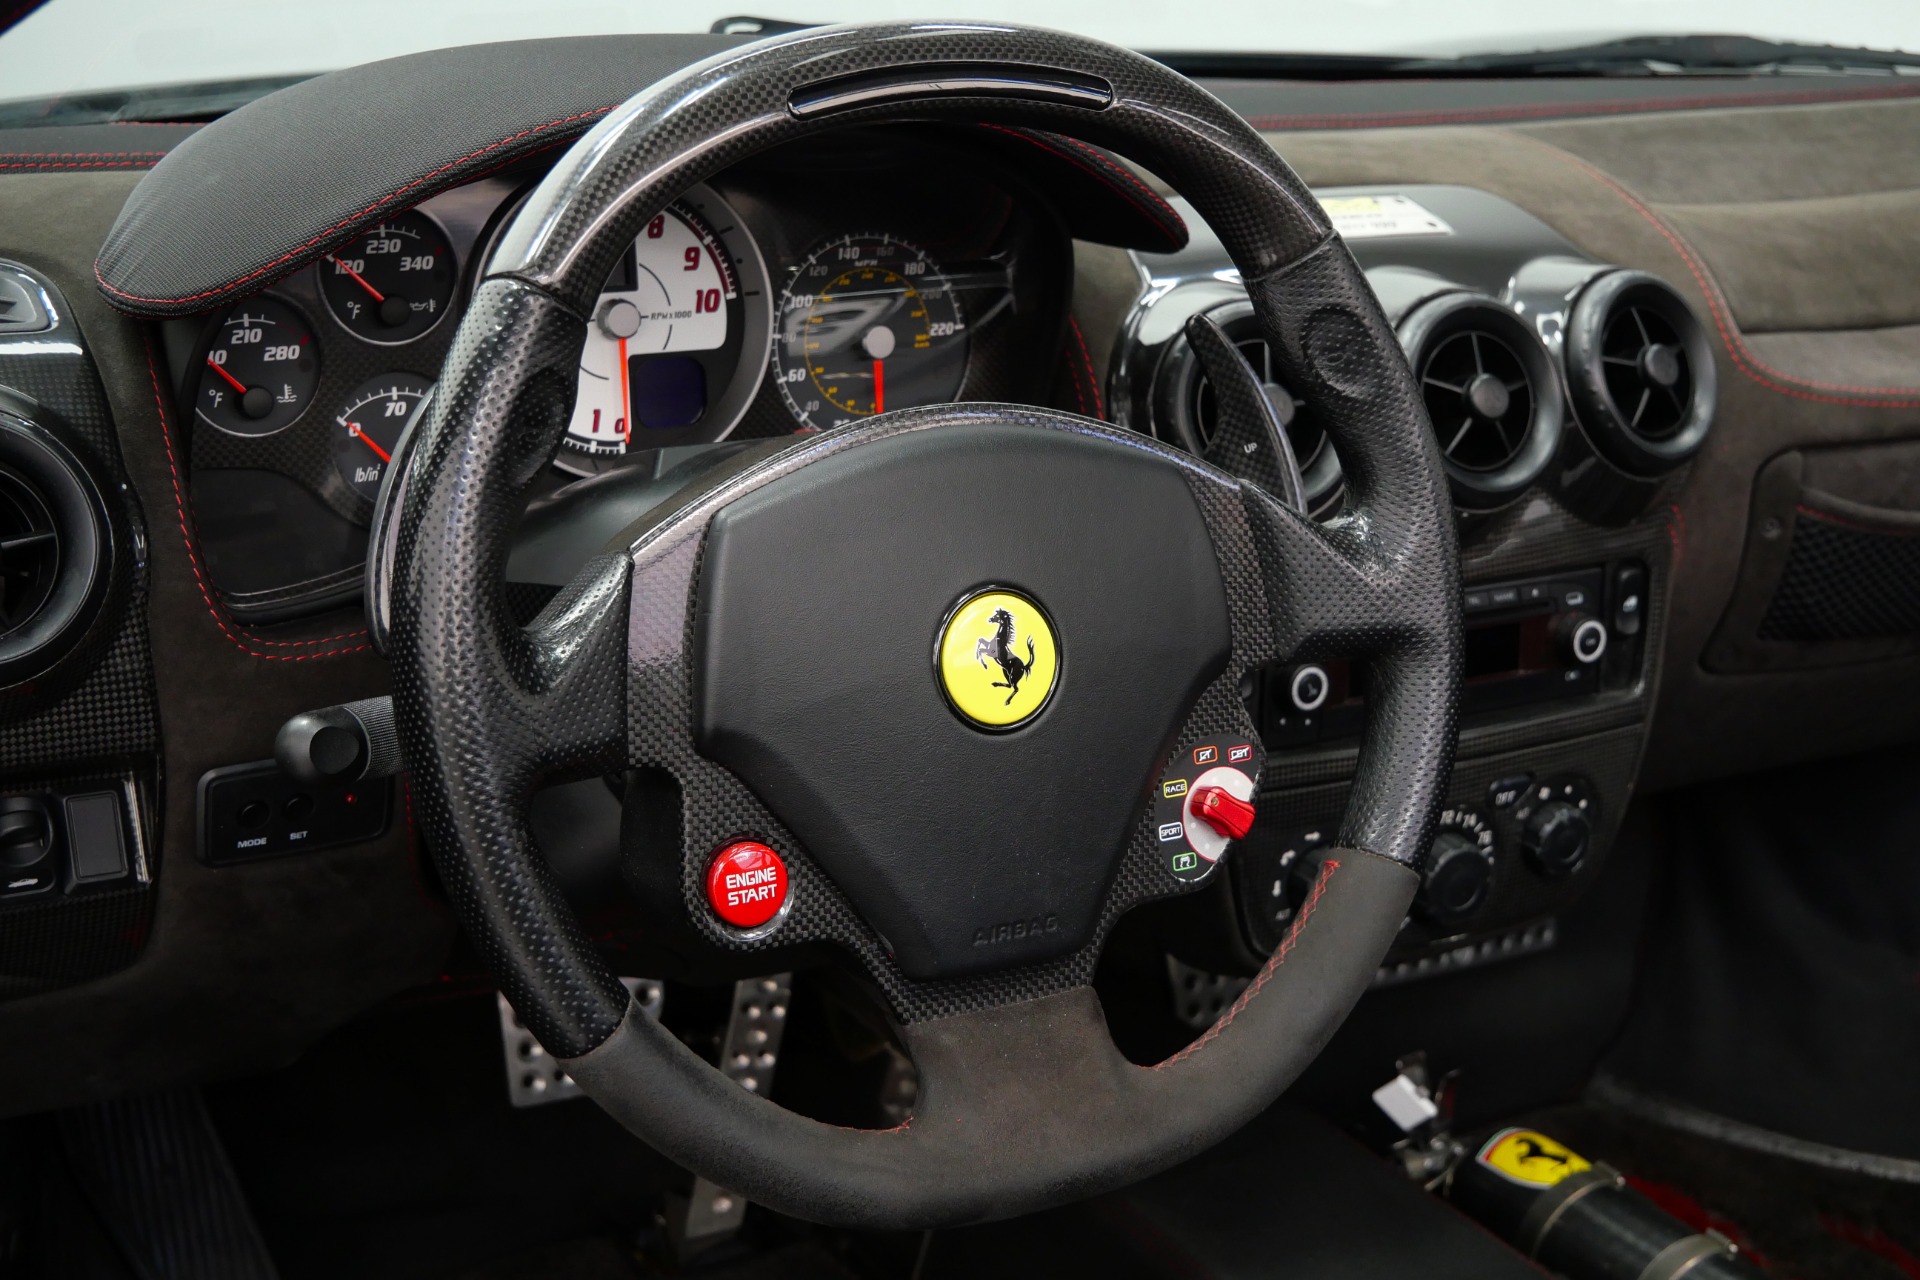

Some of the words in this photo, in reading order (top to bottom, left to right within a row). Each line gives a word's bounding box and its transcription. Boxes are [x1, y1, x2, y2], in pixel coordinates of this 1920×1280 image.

[648, 214, 665, 238] 8
[366, 239, 401, 254] 230
[838, 247, 860, 260] 140
[400, 256, 434, 272] 340
[684, 247, 700, 271] 9
[809, 265, 828, 277] 120
[904, 262, 926, 275] 180
[695, 289, 721, 314] 10
[790, 294, 813, 308] 100
[930, 321, 954, 336] 220
[231, 328, 262, 345] 210
[263, 345, 300, 362] 280
[788, 368, 806, 382] 60
[384, 402, 407, 417] 70
[805, 400, 820, 411] 40
[592, 409, 601, 433] 1
[1243, 442, 1258, 454] UP
[1165, 782, 1186, 794] RACE
[1161, 826, 1181, 837] SPORT
[237, 837, 267, 849] MODE
[726, 866, 777, 890] ENGINE
[727, 883, 778, 907] START
[972, 914, 1058, 947] AIRBAG
